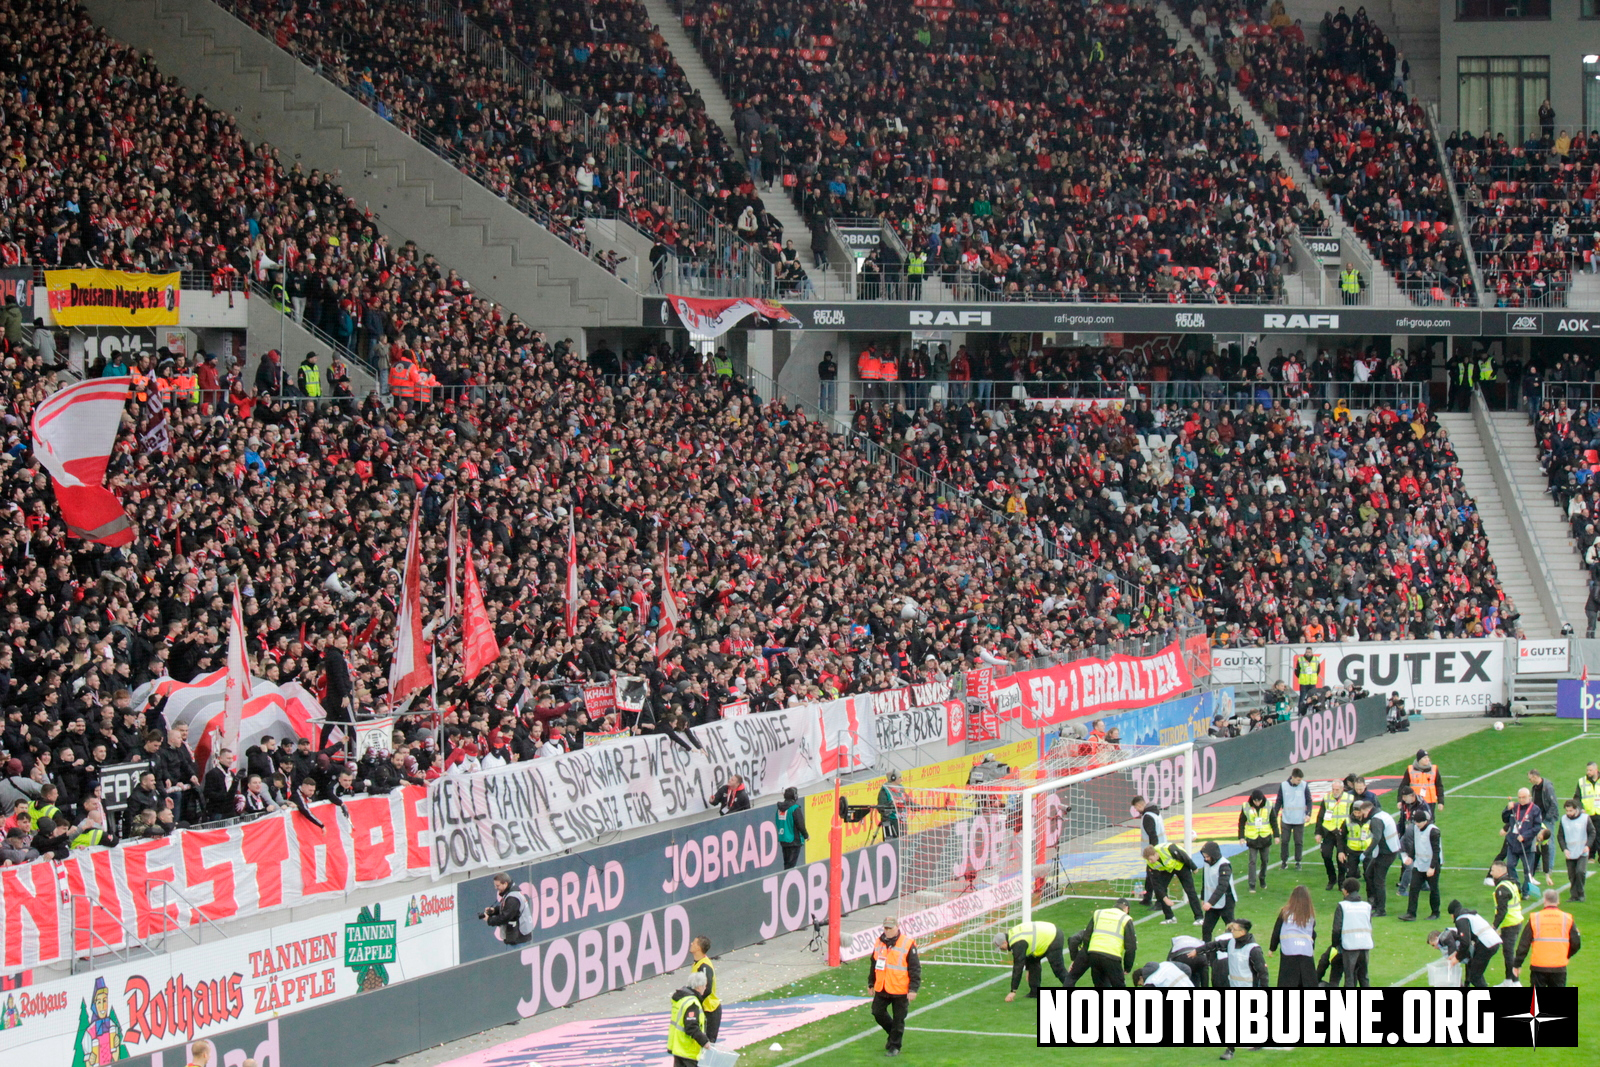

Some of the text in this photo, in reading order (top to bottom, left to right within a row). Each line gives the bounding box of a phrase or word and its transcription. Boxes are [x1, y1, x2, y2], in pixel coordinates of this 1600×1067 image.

[841, 234, 881, 245] OBRAD
[1304, 242, 1339, 253] BRAD
[70, 283, 113, 307] Dreisam
[115, 285, 145, 315] Magic
[813, 309, 844, 318] GET IN
[813, 316, 846, 325] TOUCH
[909, 311, 992, 326] RAFI
[1054, 314, 1115, 325] rafi-group.com
[1175, 312, 1204, 321] GET IN
[1176, 319, 1205, 328] TOUCH
[1264, 314, 1340, 329] RAFI
[1395, 317, 1451, 328] rafi-group.com
[1557, 319, 1590, 332] AOK
[1224, 656, 1263, 666] GUTEX
[1531, 647, 1566, 657] GUTEX
[1337, 650, 1493, 687] GUTEX
[1028, 669, 1080, 719] 50+1
[1080, 650, 1183, 704] ERHALTEN
[1455, 693, 1493, 706] FASER
[1159, 716, 1211, 746] EUROPA PARK
[1289, 702, 1357, 765] JOBRAD
[432, 767, 558, 832] HELLMANN:
[693, 724, 736, 764] WIE
[734, 714, 796, 757] SCHNEE
[435, 823, 489, 875] DOCH
[491, 818, 551, 860] DEIN
[549, 795, 623, 844] EINSATZ
[623, 791, 659, 827] FÜR
[659, 767, 709, 816] 50+1
[662, 821, 778, 894] JOBRAD
[419, 894, 455, 918] Rothaus
[494, 860, 625, 942] OBRAD
[947, 894, 984, 920] JOBRAD
[347, 923, 395, 943] TANNEN
[899, 910, 940, 937] JOBRAD
[248, 931, 337, 979] TANNEN
[348, 943, 393, 963] ZÄPFLE
[517, 904, 691, 1019] JOBRAD
[254, 967, 336, 1015] ZÄPFLE
[19, 990, 68, 1019] Rothaus
[122, 971, 245, 1045] Rothaus
